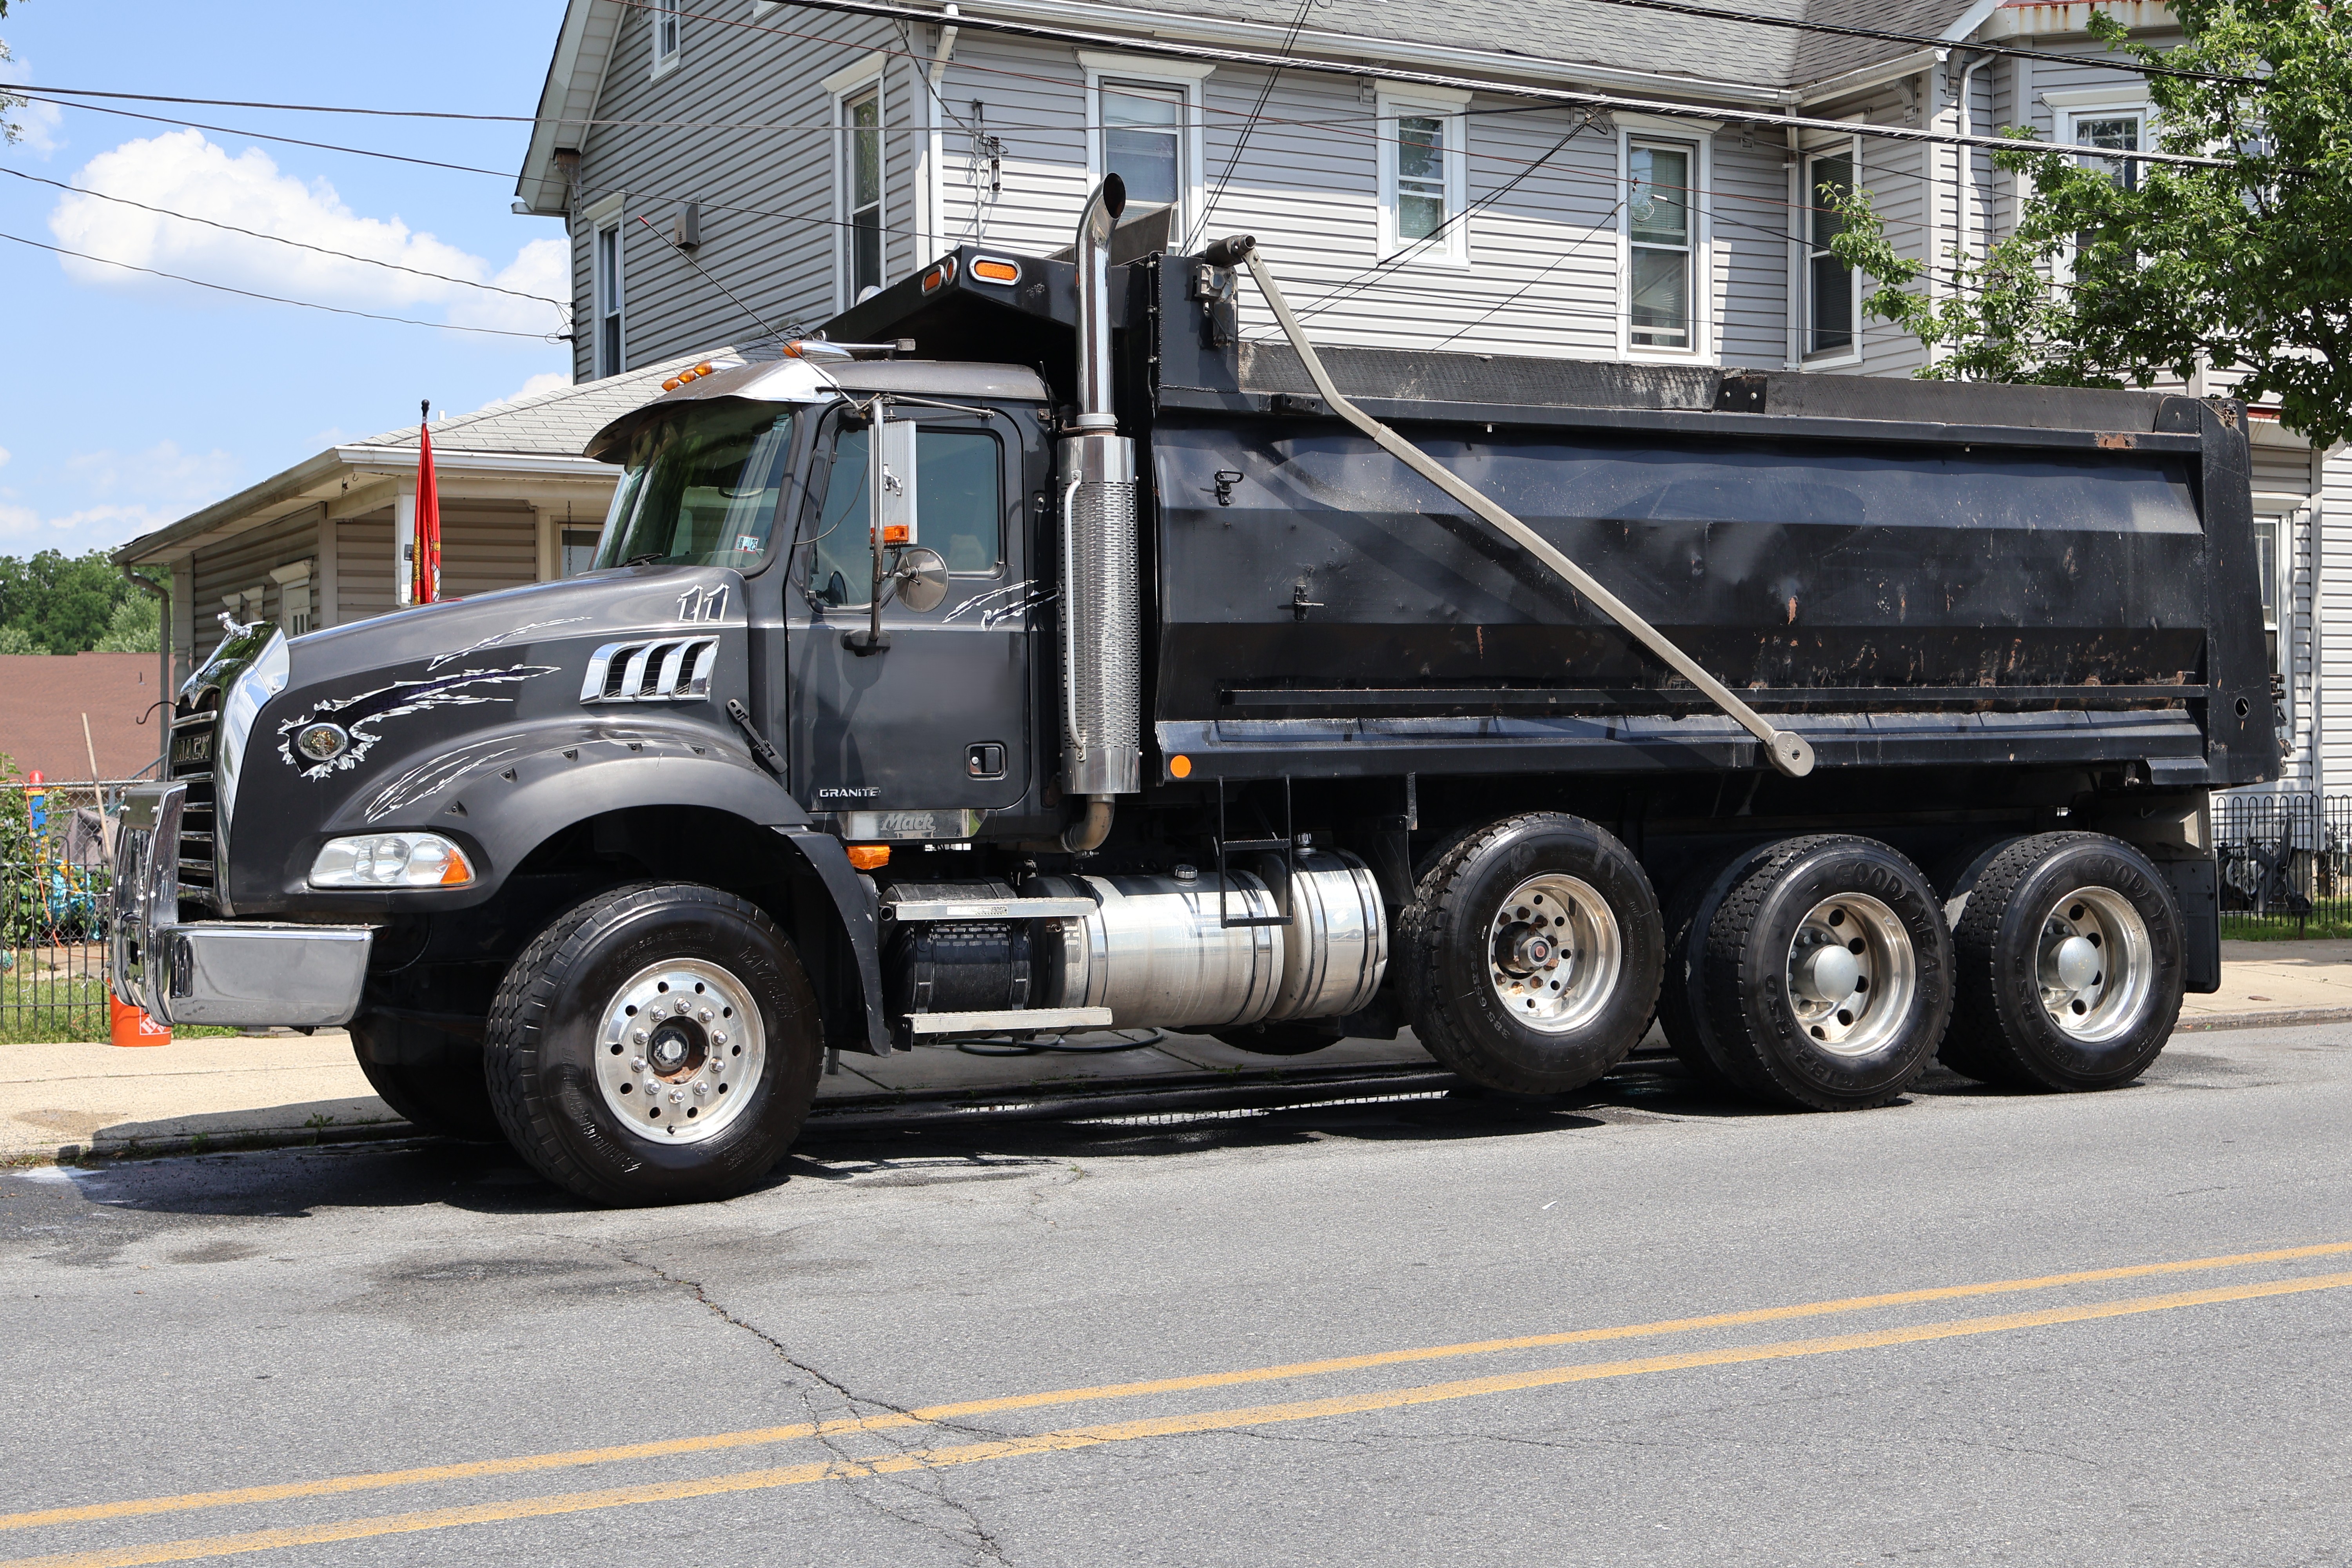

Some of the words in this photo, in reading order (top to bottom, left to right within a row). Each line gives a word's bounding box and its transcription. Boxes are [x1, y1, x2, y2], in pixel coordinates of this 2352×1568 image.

[739, 537, 744, 549] 6
[750, 539, 758, 550] 25
[677, 583, 730, 622] 11
[174, 735, 210, 762] MACK
[820, 788, 878, 797] GRANITE
[880, 813, 936, 831] Mack
[1765, 974, 1794, 1041] RSD
